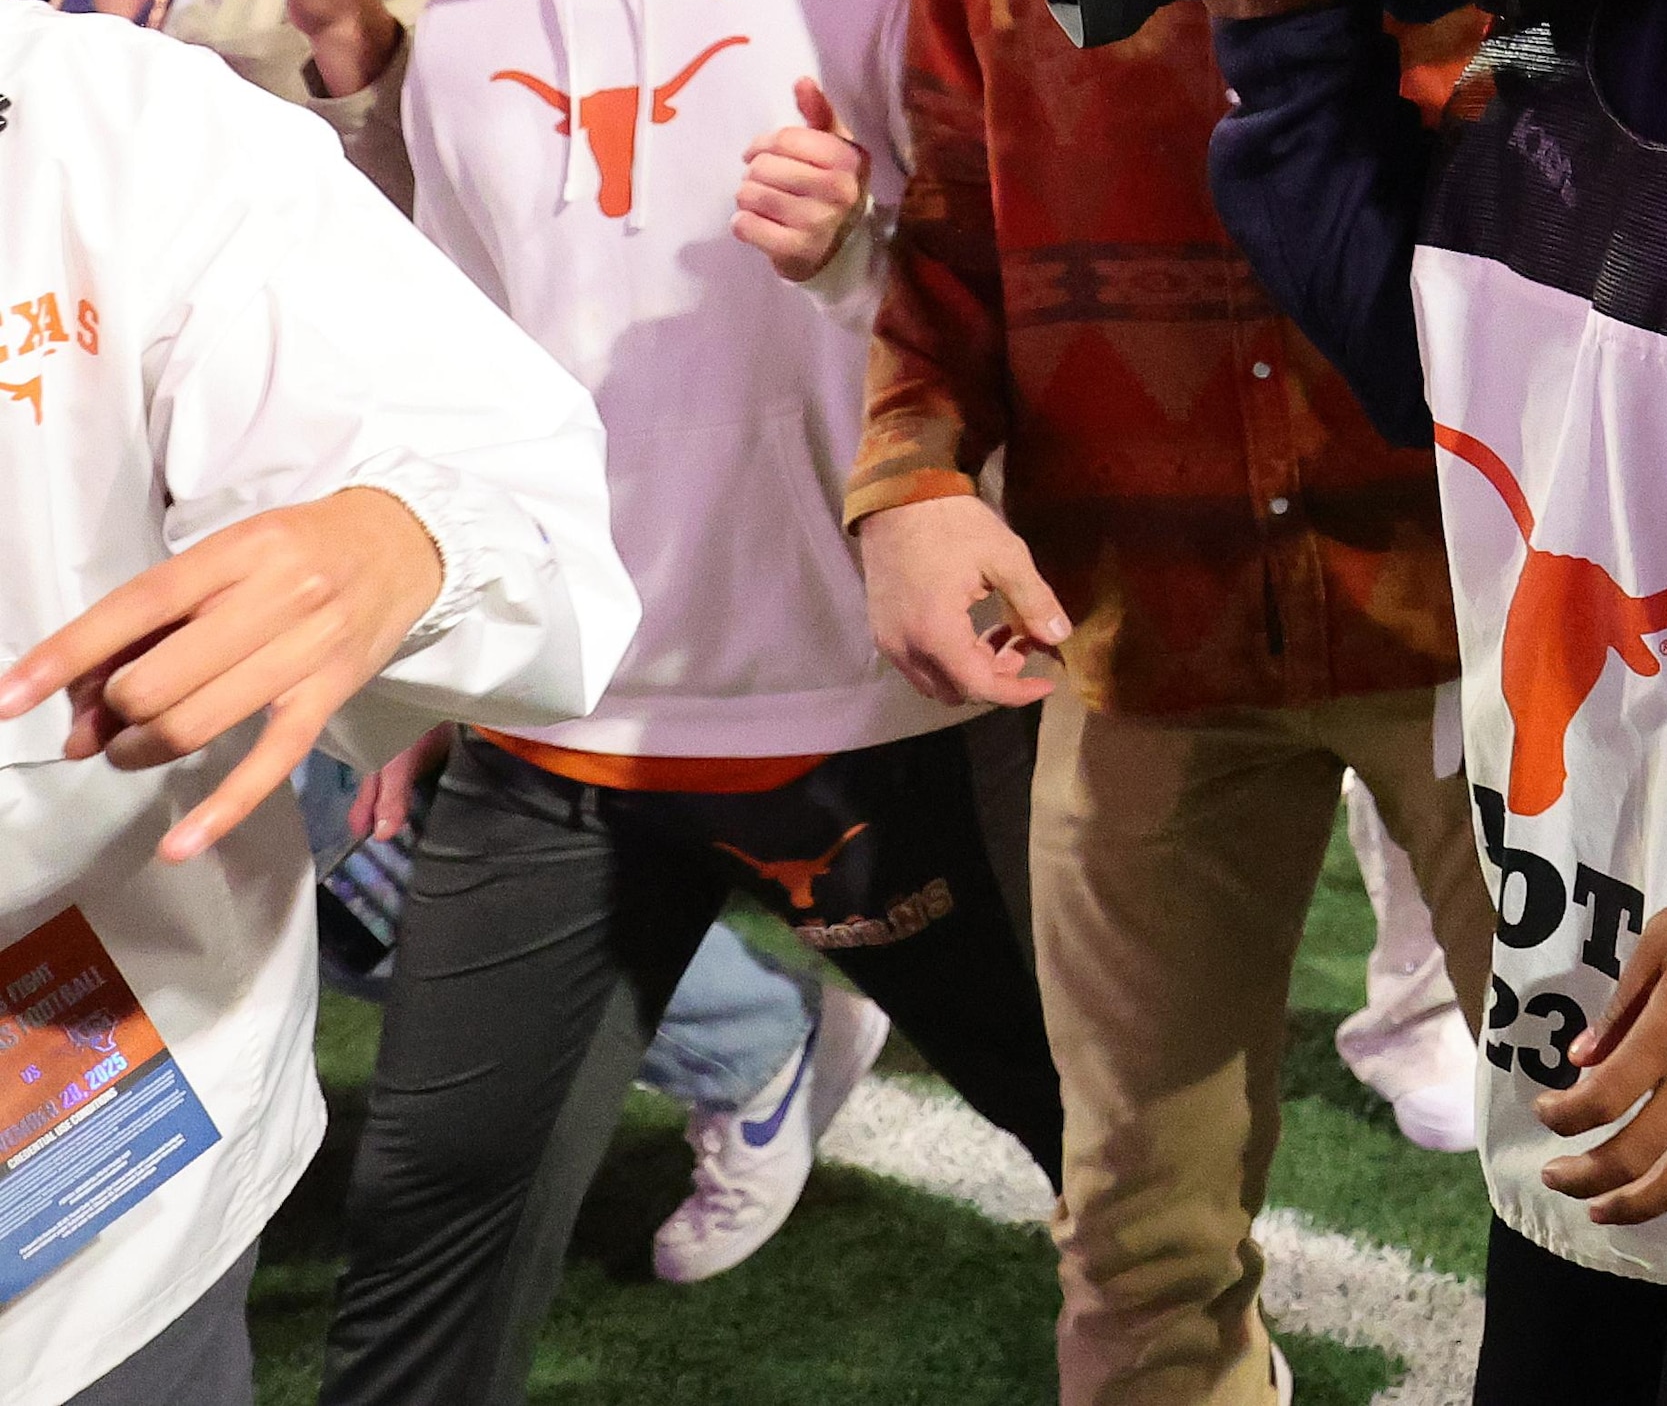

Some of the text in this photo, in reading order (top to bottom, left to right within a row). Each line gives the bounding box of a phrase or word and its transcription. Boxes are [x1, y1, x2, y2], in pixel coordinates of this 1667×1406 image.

[0, 292, 99, 356] XAS
[83, 1051, 129, 1091] 2025
[6, 1130, 58, 1170] CREDENTIAL
[54, 1117, 74, 1137] USE
